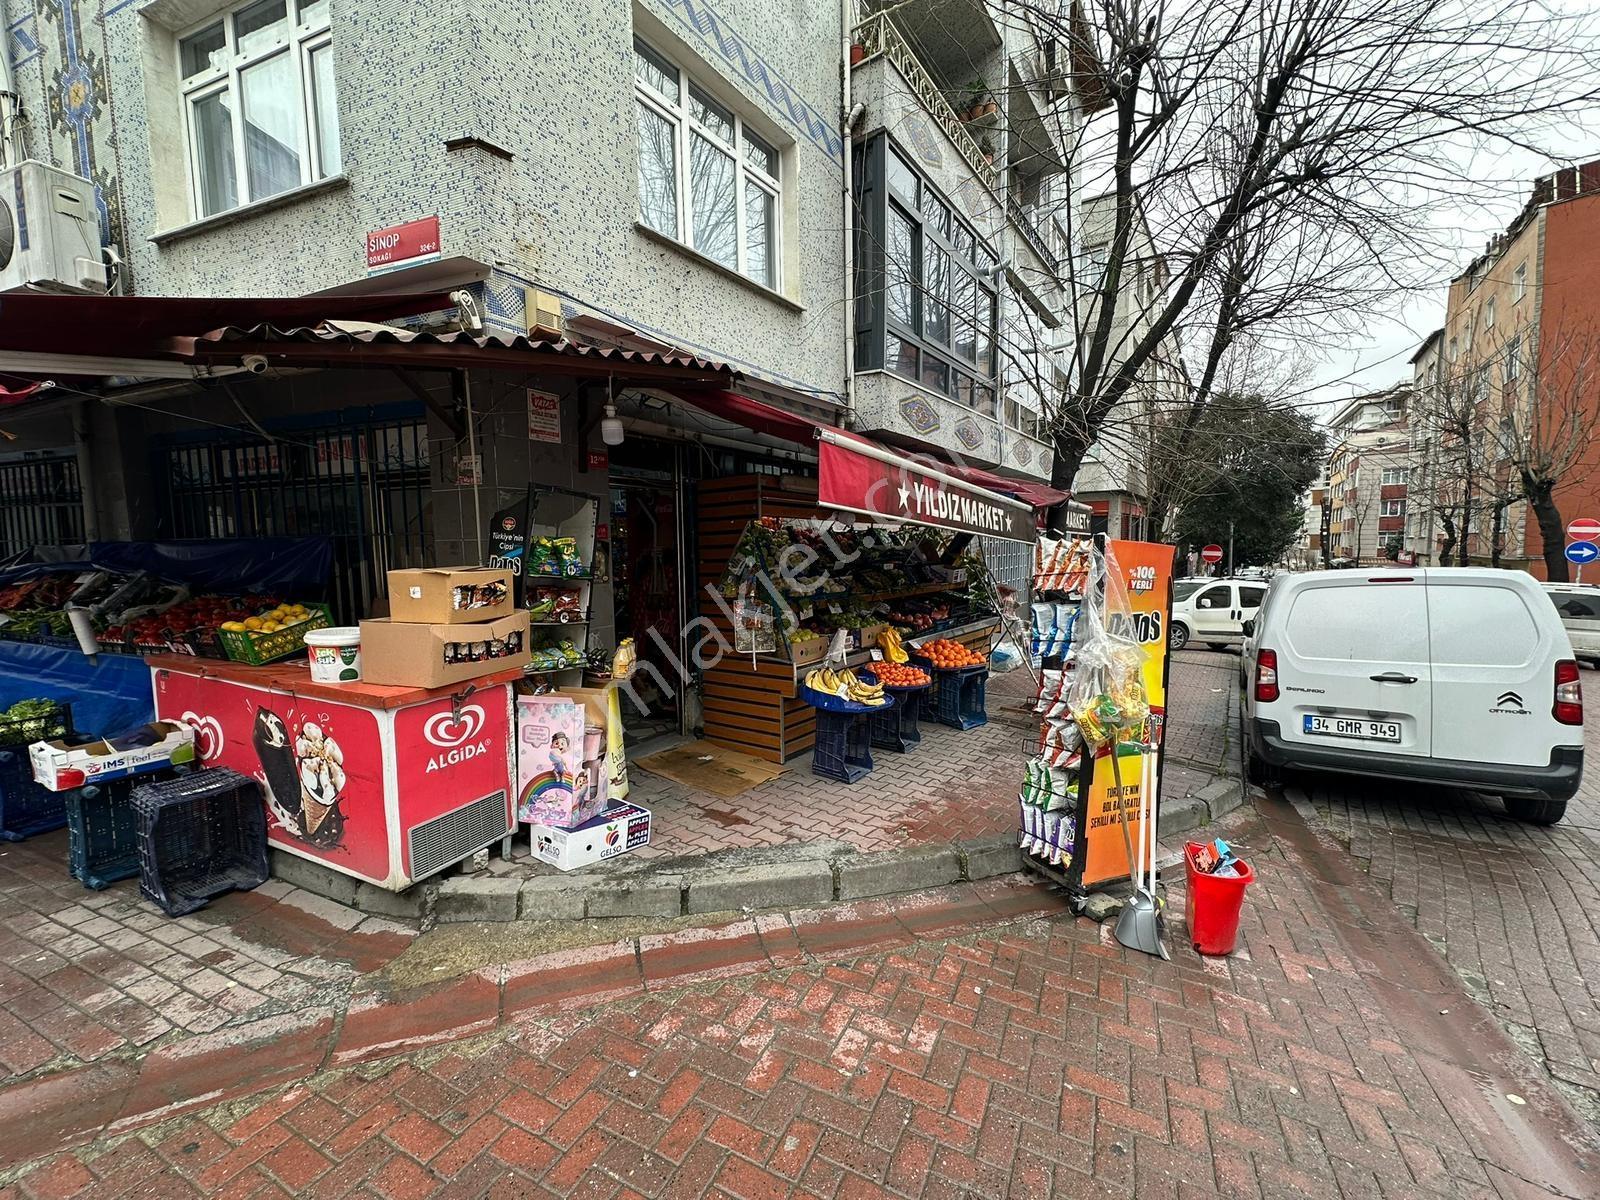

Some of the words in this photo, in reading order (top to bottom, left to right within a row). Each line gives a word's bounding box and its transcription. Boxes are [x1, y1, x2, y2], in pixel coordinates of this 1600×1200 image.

[369, 233, 400, 252] SİNOP
[492, 532, 524, 542] Türkiye'nin
[499, 542, 514, 550] Cipsi
[1129, 566, 1155, 579] %100
[1131, 580, 1153, 590] YERLİ
[1313, 718, 1329, 731] 34
[1337, 720, 1362, 734] GMR
[1370, 723, 1396, 737] 949
[132, 753, 151, 764] feel
[1102, 801, 1111, 813] BOL
[629, 816, 649, 827] APPLES
[629, 823, 648, 833] APPLES
[627, 836, 647, 847] APPLES
[544, 843, 561, 857] GELSO
[600, 845, 622, 858] GELSO
